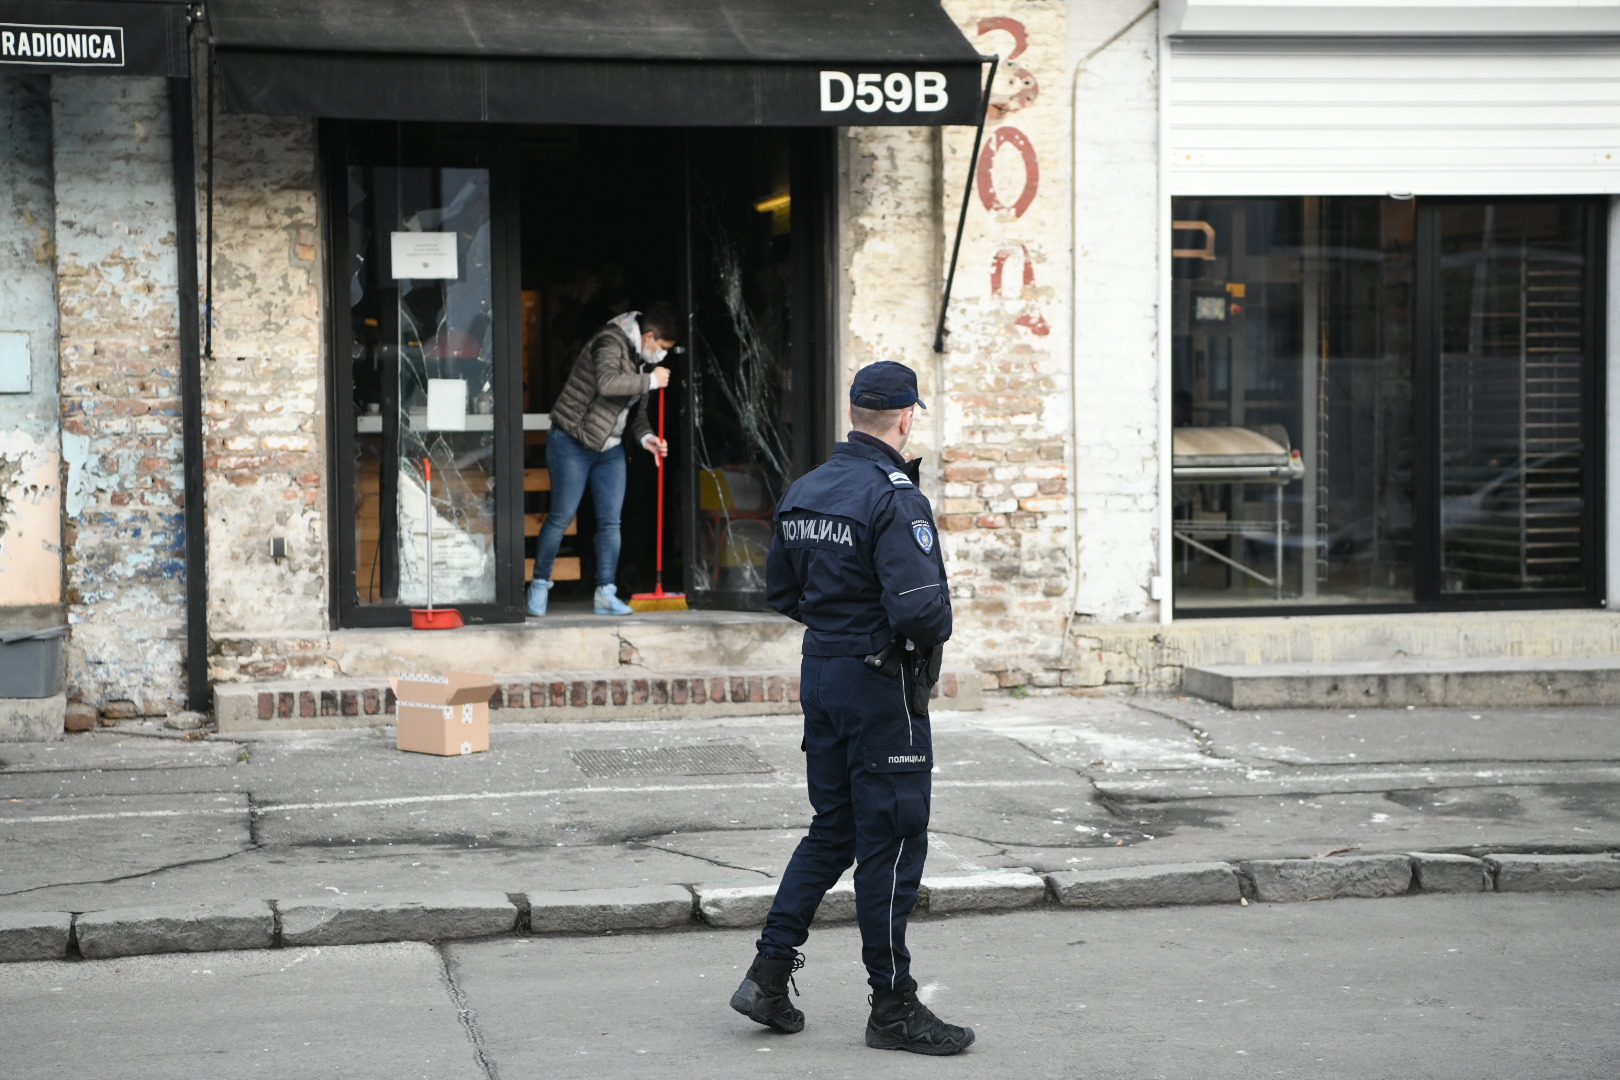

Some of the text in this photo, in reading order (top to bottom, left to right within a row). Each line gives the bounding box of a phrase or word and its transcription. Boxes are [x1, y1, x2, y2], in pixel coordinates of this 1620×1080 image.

[1, 31, 116, 59] RADIONICA
[820, 71, 949, 113] D59B
[782, 519, 853, 547] ПОЛИЦИЈА
[888, 755, 926, 764] ПОЛИЦИЈА
